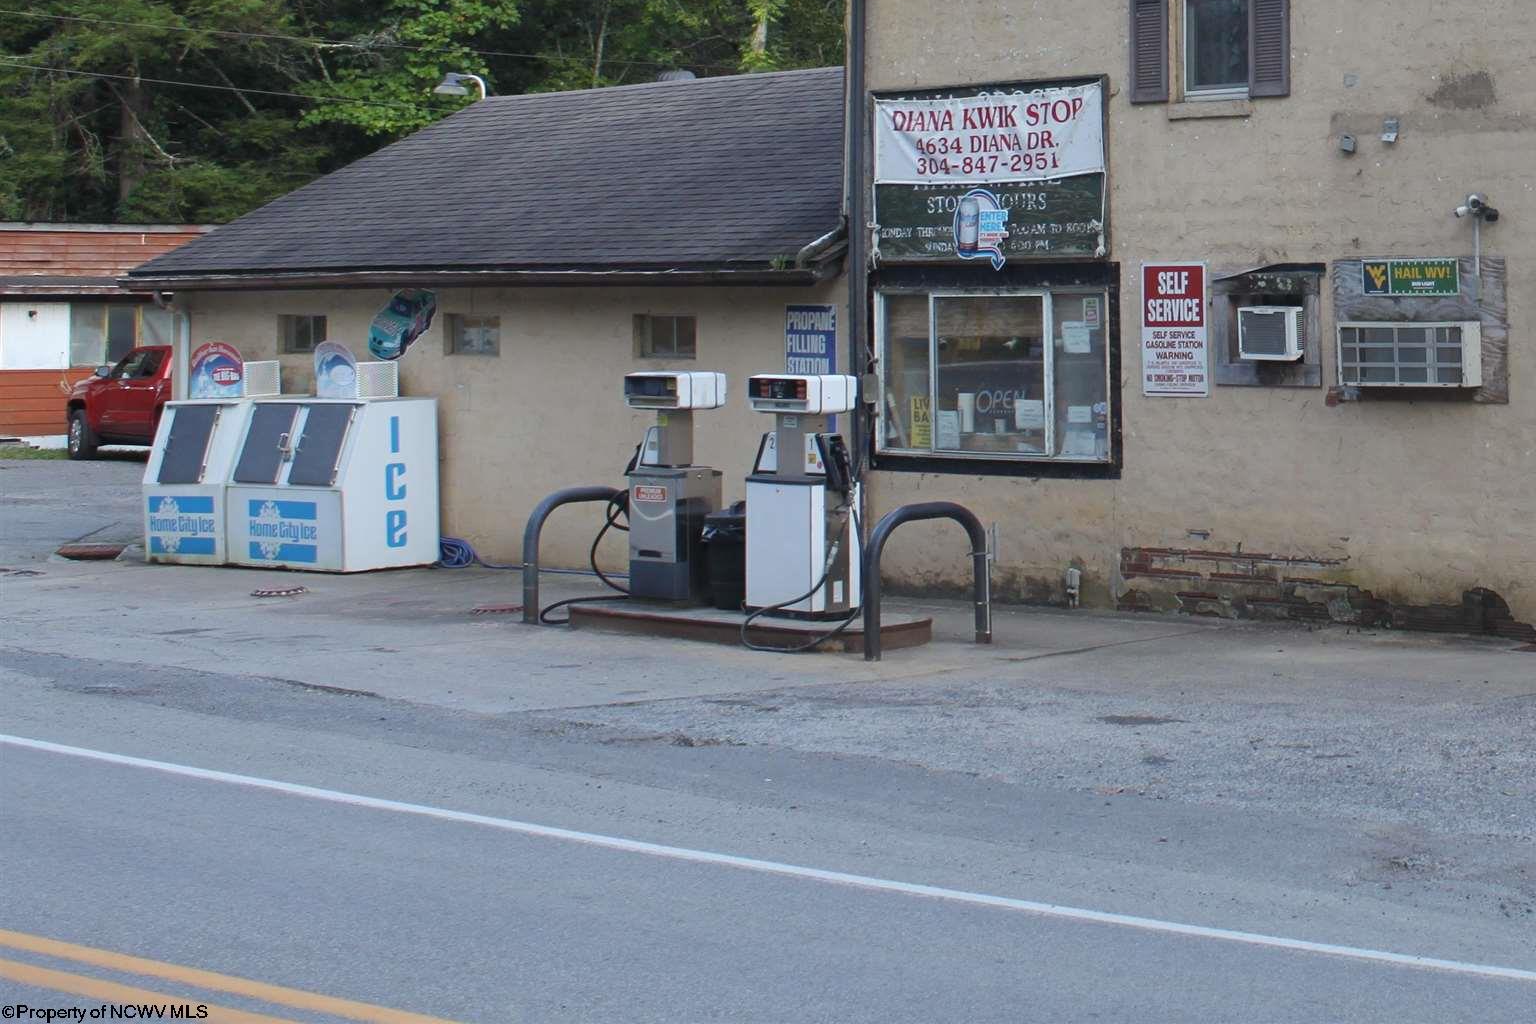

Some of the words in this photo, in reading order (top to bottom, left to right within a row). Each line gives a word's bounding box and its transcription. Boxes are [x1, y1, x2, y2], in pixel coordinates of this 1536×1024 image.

[892, 109, 954, 132] DIANA
[962, 105, 1018, 130] KWIK
[1026, 97, 1083, 126] STOP
[916, 137, 963, 155] 4634
[970, 134, 1021, 154] DIANA
[1027, 130, 1060, 150] DR.
[916, 153, 1060, 175] 304-847-2951
[980, 211, 1007, 221] ENTER
[1394, 267, 1422, 279] HAIL
[1424, 266, 1451, 279] WV!
[1158, 271, 1189, 295] SELF
[1147, 298, 1200, 322] SERVICE
[787, 310, 836, 331] PROPANE
[787, 334, 826, 354] FILLING
[1145, 340, 1177, 349] GASOLINE
[1177, 340, 1203, 349] STATION
[1152, 330, 1168, 339] SELF
[1169, 330, 1196, 339] SERVICE
[1155, 351, 1194, 360] WARNING
[787, 357, 830, 375] STATION
[913, 397, 930, 410] LIV
[913, 410, 930, 423] BA
[150, 516, 178, 532] Home
[178, 516, 198, 536] City
[199, 517, 215, 533] Ice
[250, 519, 278, 538] Home
[279, 521, 299, 543] City
[300, 522, 317, 540] Ice
